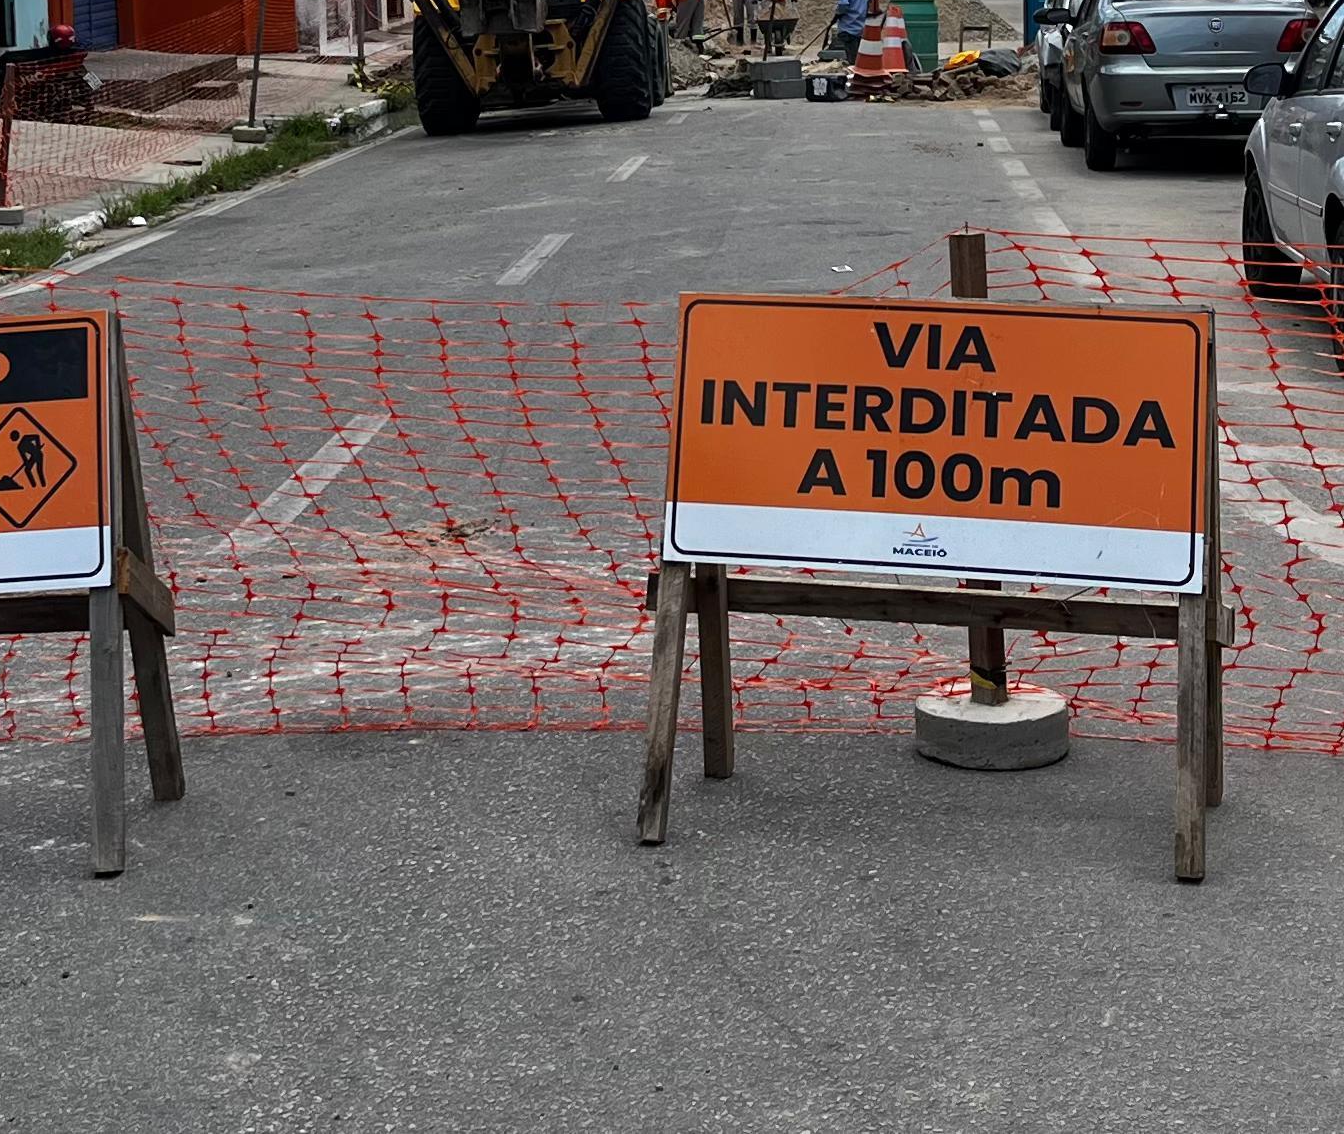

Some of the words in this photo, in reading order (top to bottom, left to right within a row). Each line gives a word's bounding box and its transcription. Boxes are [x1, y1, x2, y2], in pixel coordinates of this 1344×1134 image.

[873, 322, 996, 373] VIA
[700, 379, 1175, 449] INTERDITADA
[797, 448, 847, 496] A
[866, 449, 1061, 509] 100m
